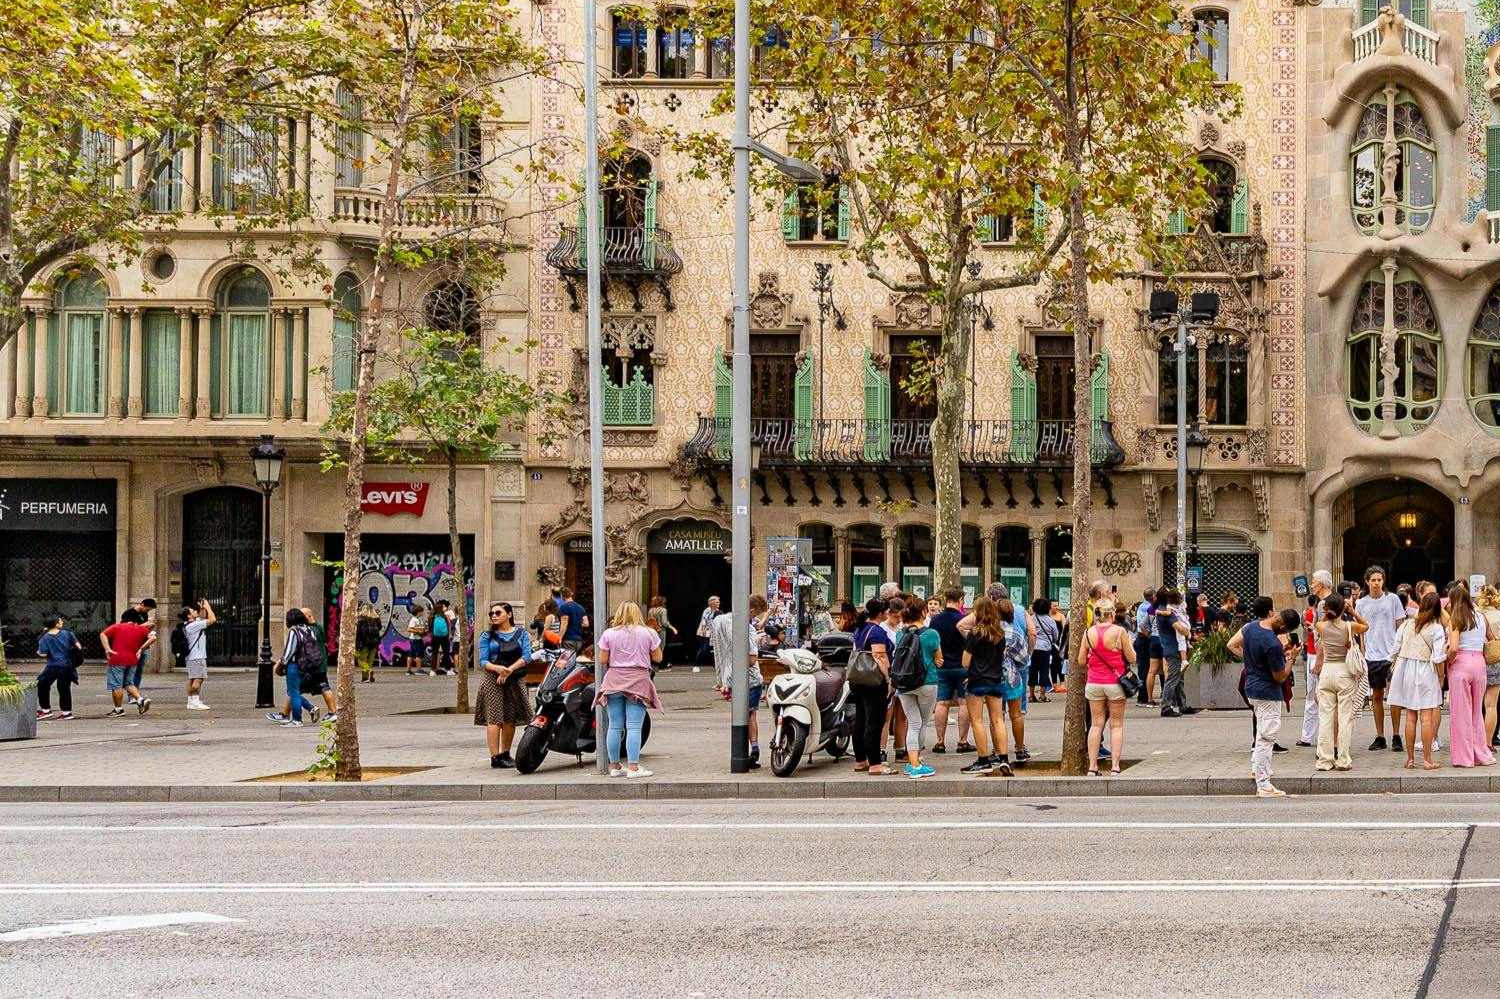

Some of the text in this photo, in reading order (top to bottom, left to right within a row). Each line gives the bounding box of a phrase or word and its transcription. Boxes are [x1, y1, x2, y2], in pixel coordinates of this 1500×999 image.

[20, 502, 108, 515] PERFUMERIA
[668, 529, 692, 539] CASA
[665, 539, 724, 551] AMATLLER
